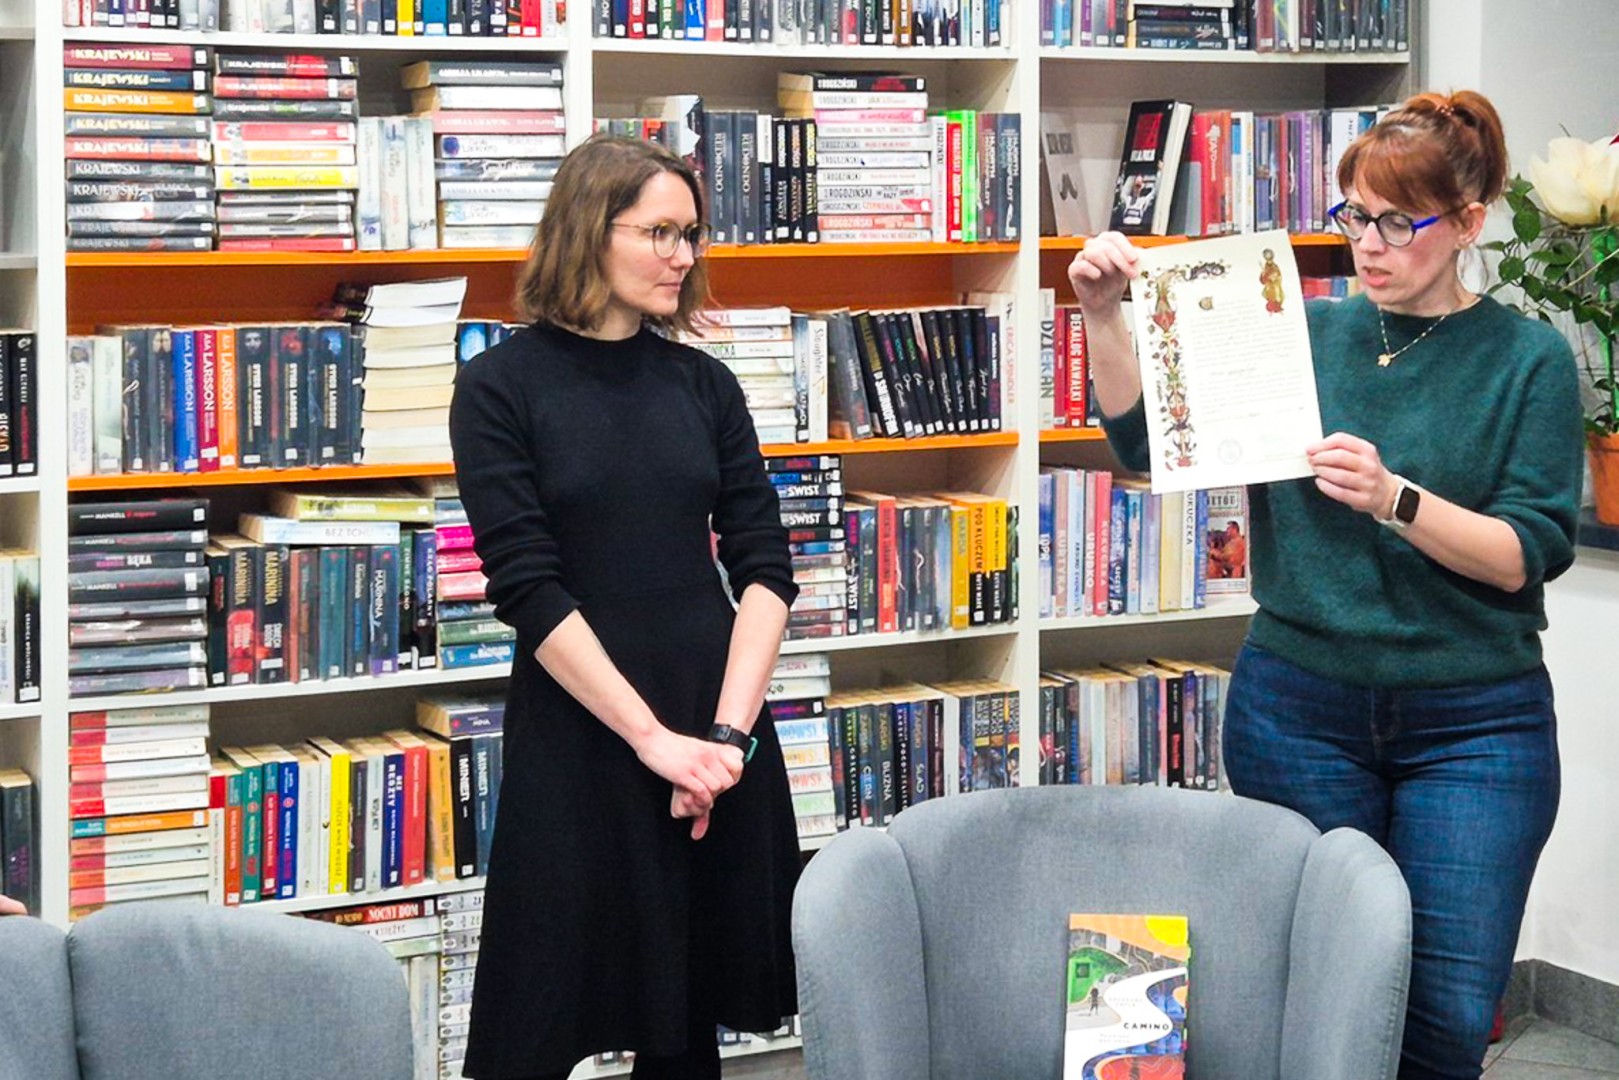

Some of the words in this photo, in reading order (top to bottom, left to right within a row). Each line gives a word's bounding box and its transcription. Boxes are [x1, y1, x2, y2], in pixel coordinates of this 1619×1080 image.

[75, 48, 150, 61] KRAJEWSKI
[73, 72, 149, 85] KRAJEWSKI
[73, 93, 148, 106] KRAJEWSKI
[75, 117, 149, 129] KRAJEWSKI
[74, 142, 149, 153] KRAJEWSKI
[75, 164, 140, 174] KRAJEWSKI
[714, 132, 724, 192] REDONDO
[741, 133, 751, 192] REDONDO
[73, 184, 139, 196] KRAJEWSKI
[813, 328, 824, 374] Slaughter
[1006, 326, 1015, 356] ERICA
[1069, 313, 1081, 357] DEKALOG
[184, 352, 194, 411] LARSSON
[203, 352, 214, 411] LARSSON
[222, 352, 233, 411] LARSSON
[1006, 359, 1015, 404] SPINDLER
[1040, 320, 1054, 399] DZIEKAN
[253, 389, 262, 427] LARSSON
[289, 390, 298, 428] LARSSON
[329, 390, 337, 429] LARSSON
[325, 528, 344, 537] BEZ
[975, 528, 983, 570] KLUCZEM
[235, 551, 248, 605] MARININA
[264, 551, 278, 605] MARININA
[1057, 529, 1066, 595] KURTYKA
[374, 570, 384, 619] MARININA
[387, 763, 396, 807] RESZTY
[459, 758, 470, 802] MINIER
[477, 751, 488, 796] MINIER
[1123, 1022, 1169, 1031] CAMINO
